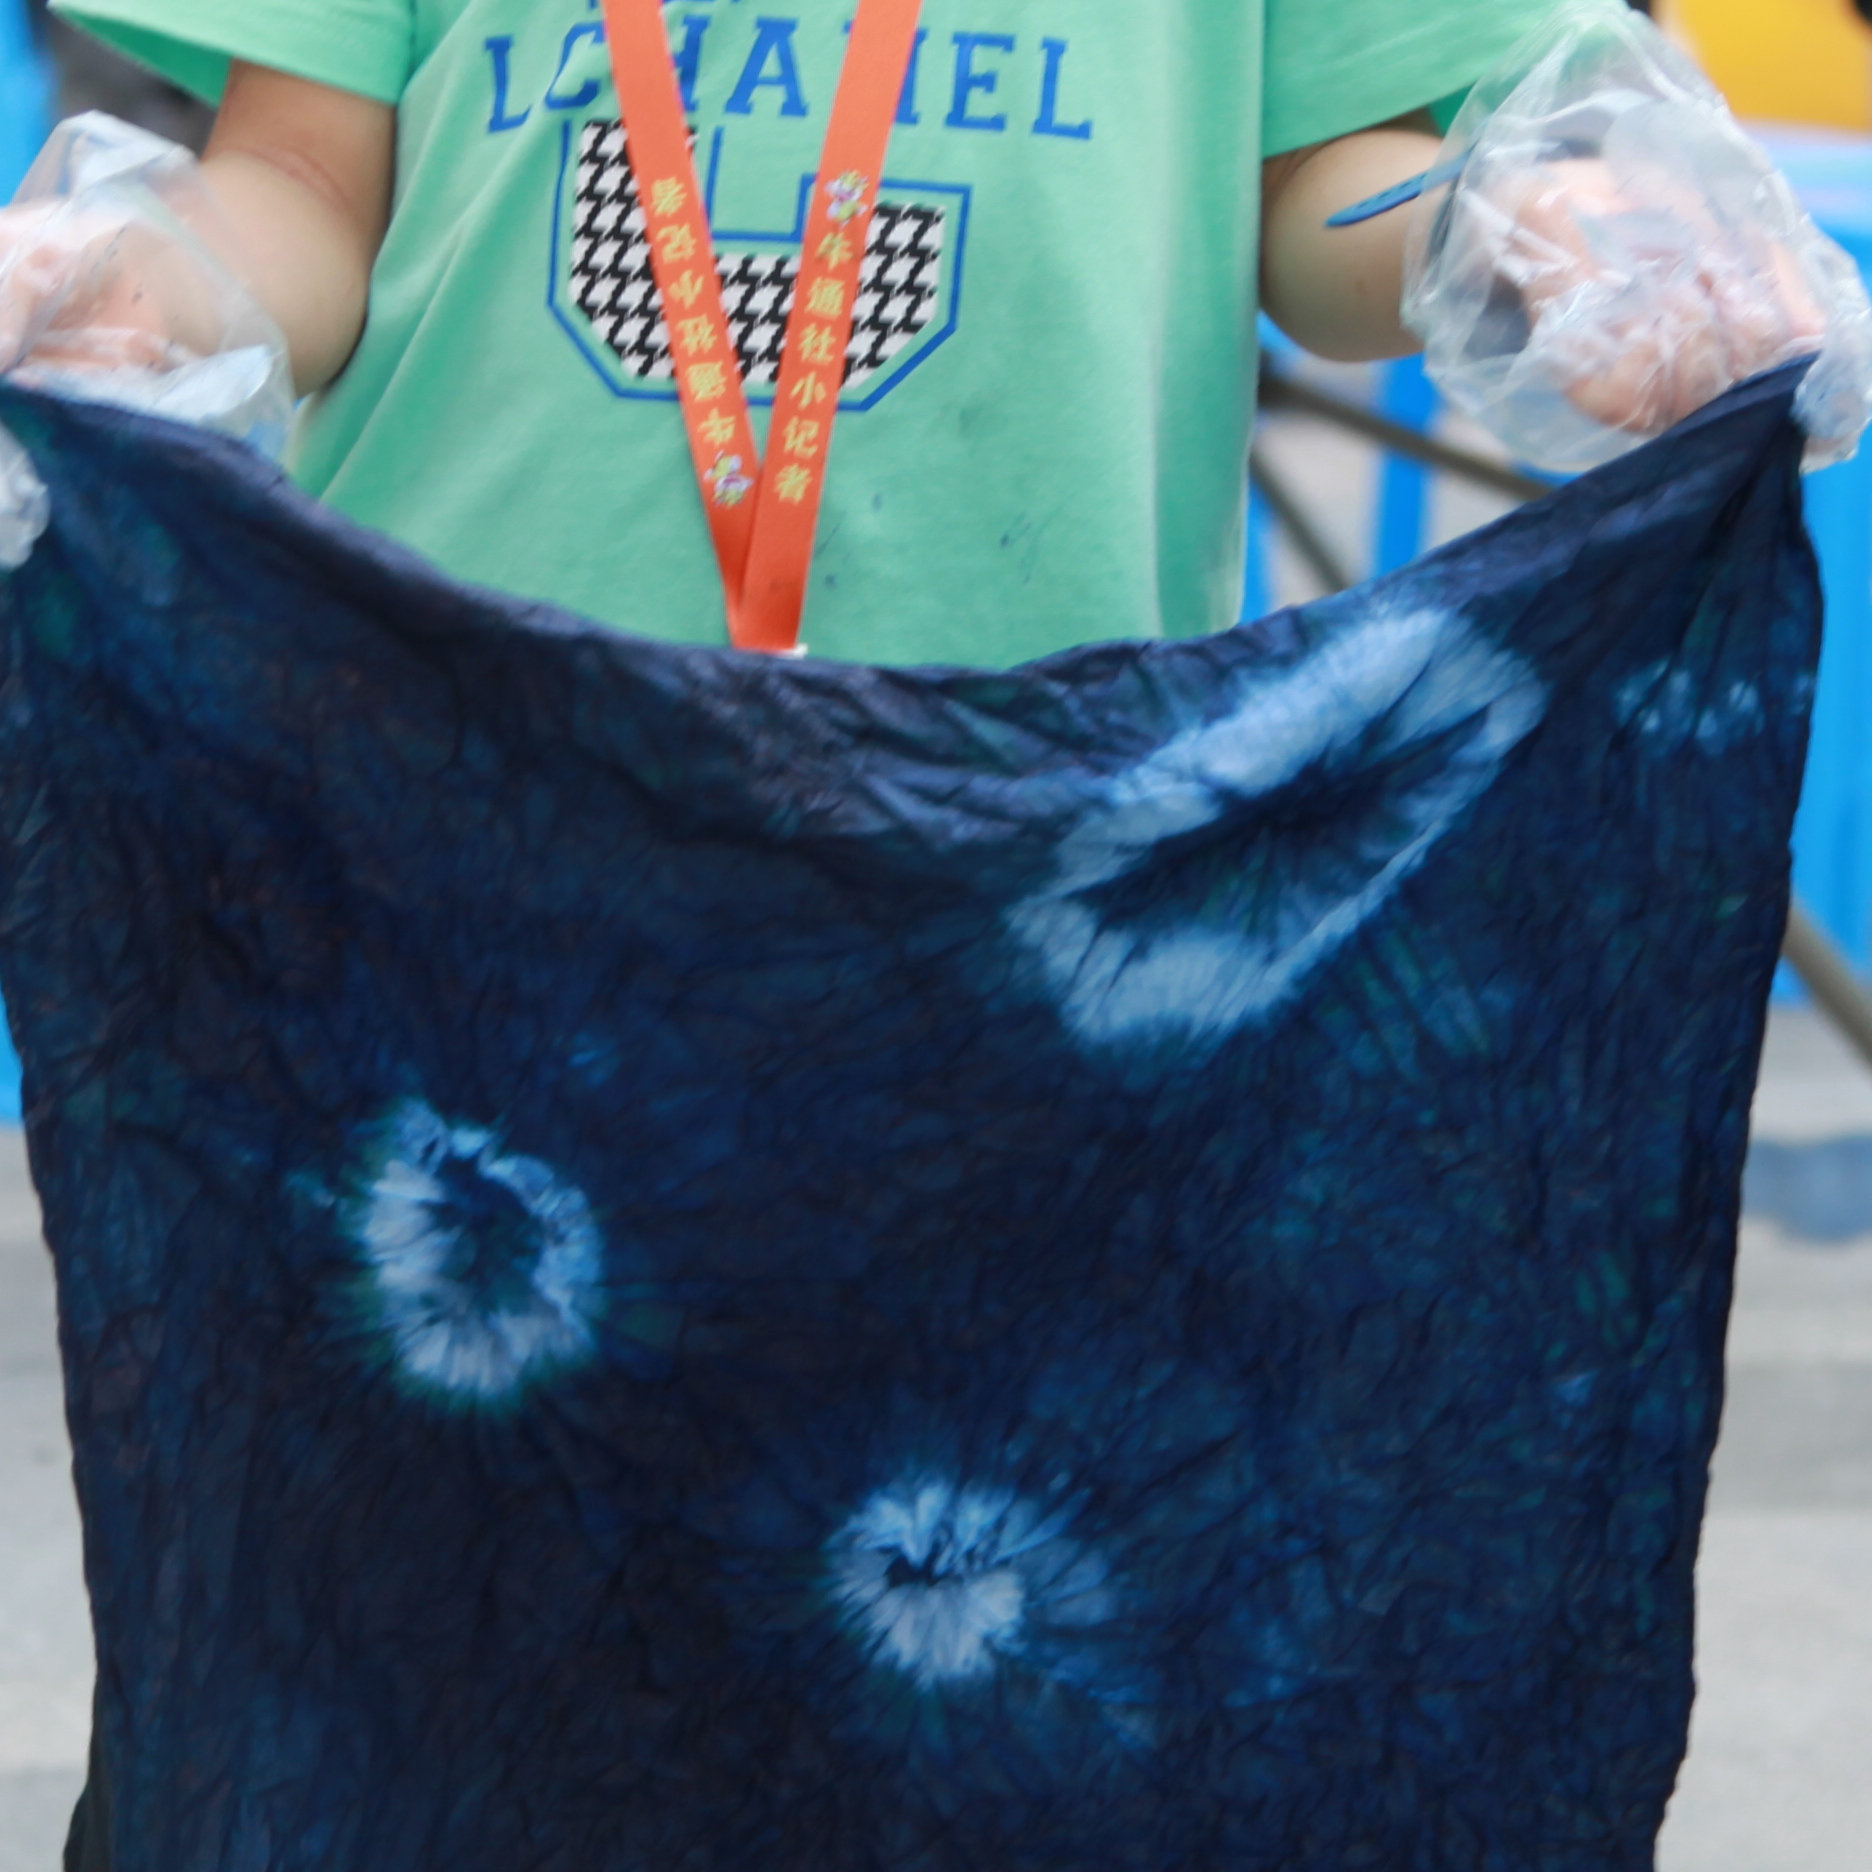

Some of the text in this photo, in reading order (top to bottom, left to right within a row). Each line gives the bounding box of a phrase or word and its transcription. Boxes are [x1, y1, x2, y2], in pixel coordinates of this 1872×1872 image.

[647, 175, 737, 448] 牛通社小记者
[773, 231, 854, 505] 牛通社小记者
